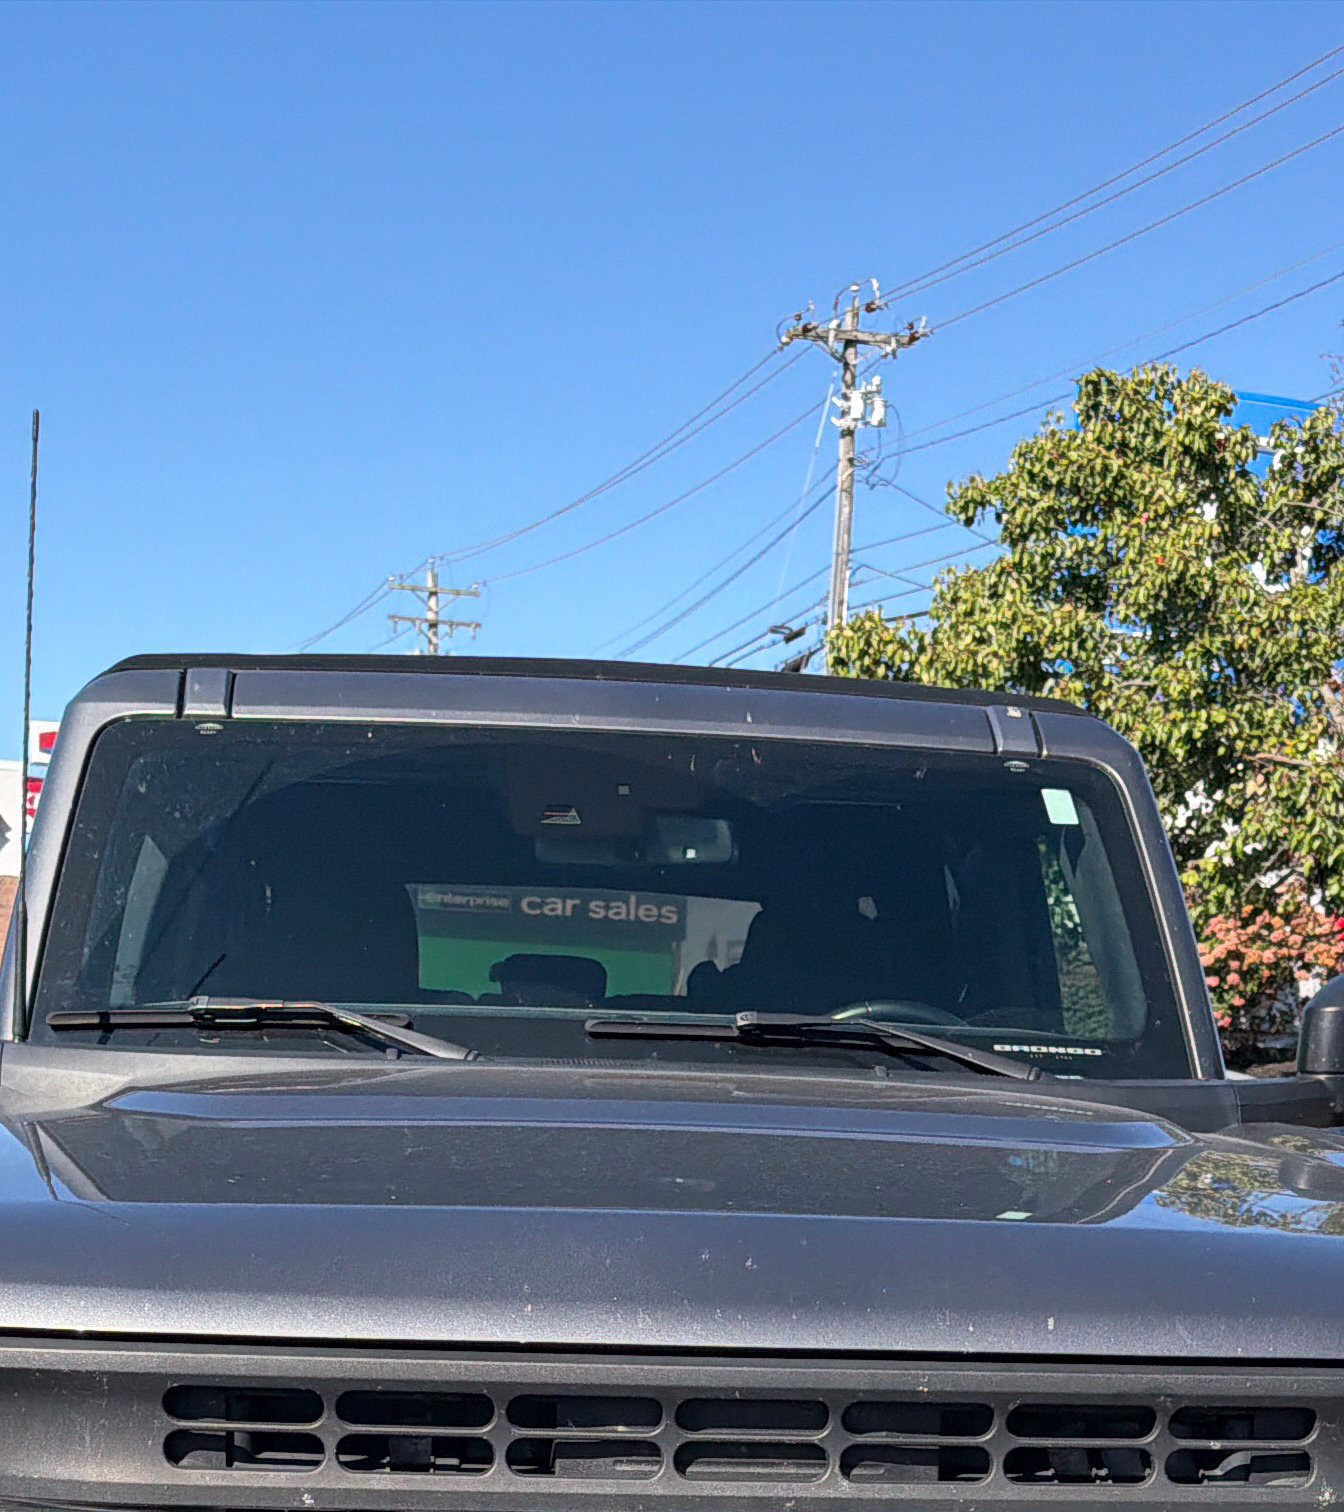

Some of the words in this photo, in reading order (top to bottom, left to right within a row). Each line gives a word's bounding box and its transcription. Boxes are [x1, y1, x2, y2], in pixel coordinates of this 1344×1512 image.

[520, 896, 581, 917] car
[588, 895, 679, 924] sales
[993, 1044, 1102, 1055] BRONCO
